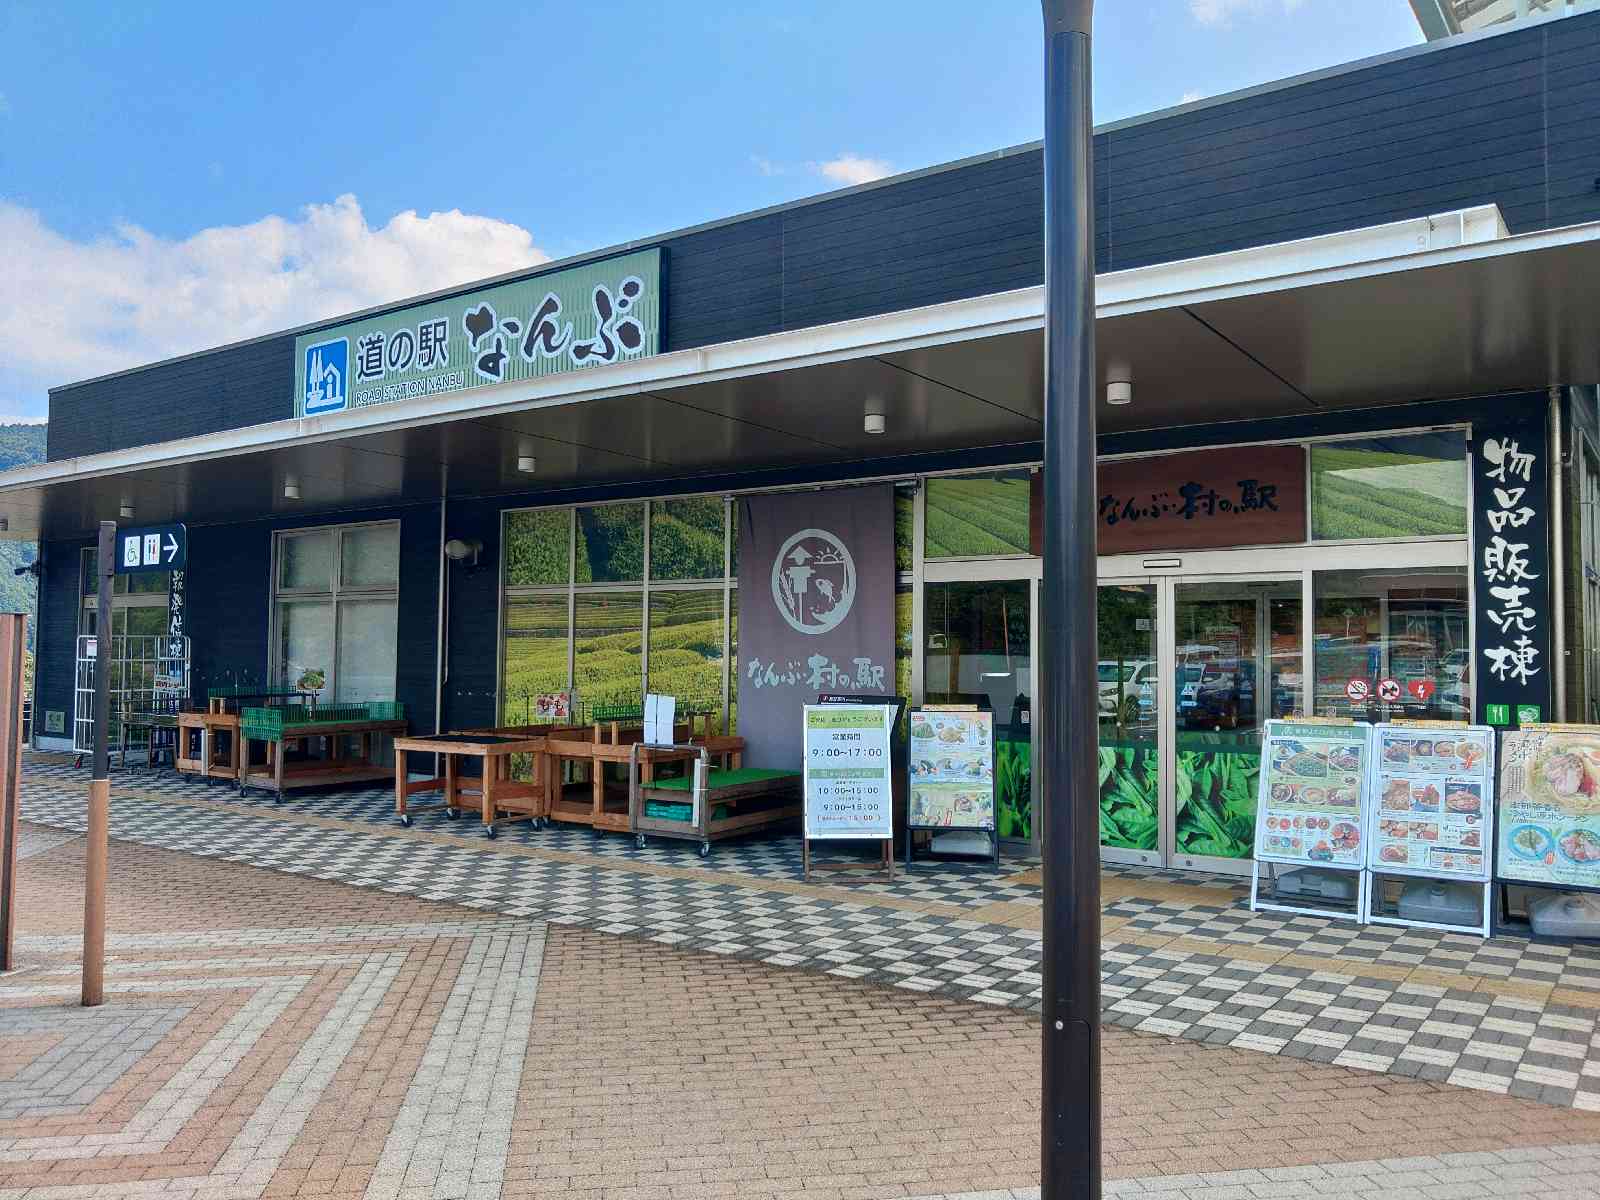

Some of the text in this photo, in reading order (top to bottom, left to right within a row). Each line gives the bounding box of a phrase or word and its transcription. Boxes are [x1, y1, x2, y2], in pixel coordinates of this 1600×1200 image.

[357, 277, 643, 381] 道の駅 なんぶ
[355, 374, 464, 403] ROAD STATION NANBU
[1480, 437, 1541, 686] 物品販売棟
[748, 653, 885, 692] なんぶ村の駅
